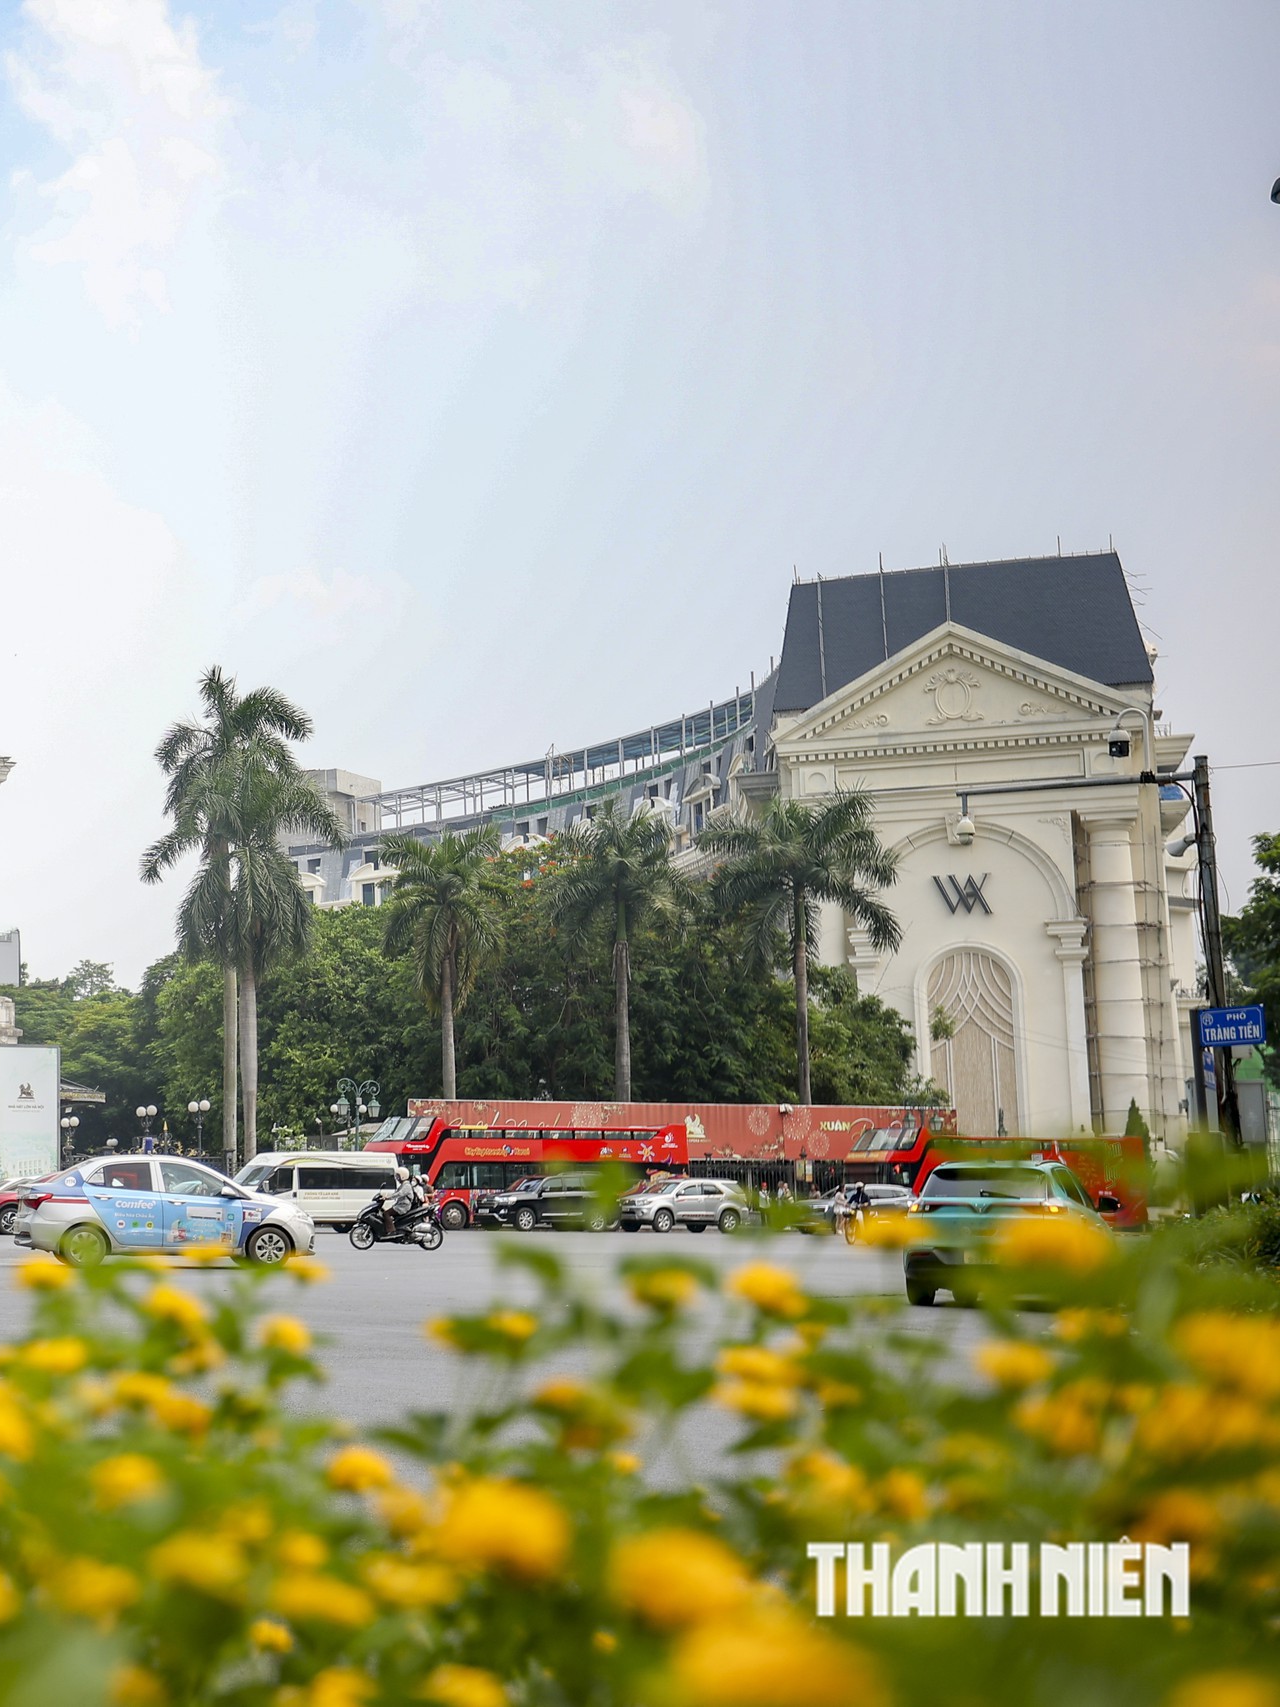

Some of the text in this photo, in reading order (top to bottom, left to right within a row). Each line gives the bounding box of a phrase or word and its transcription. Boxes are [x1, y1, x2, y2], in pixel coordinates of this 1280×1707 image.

[1226, 1010, 1247, 1021] PHỐ
[1204, 1020, 1260, 1041] TRÀNG TIỀN
[820, 1119, 851, 1132] XUÂN
